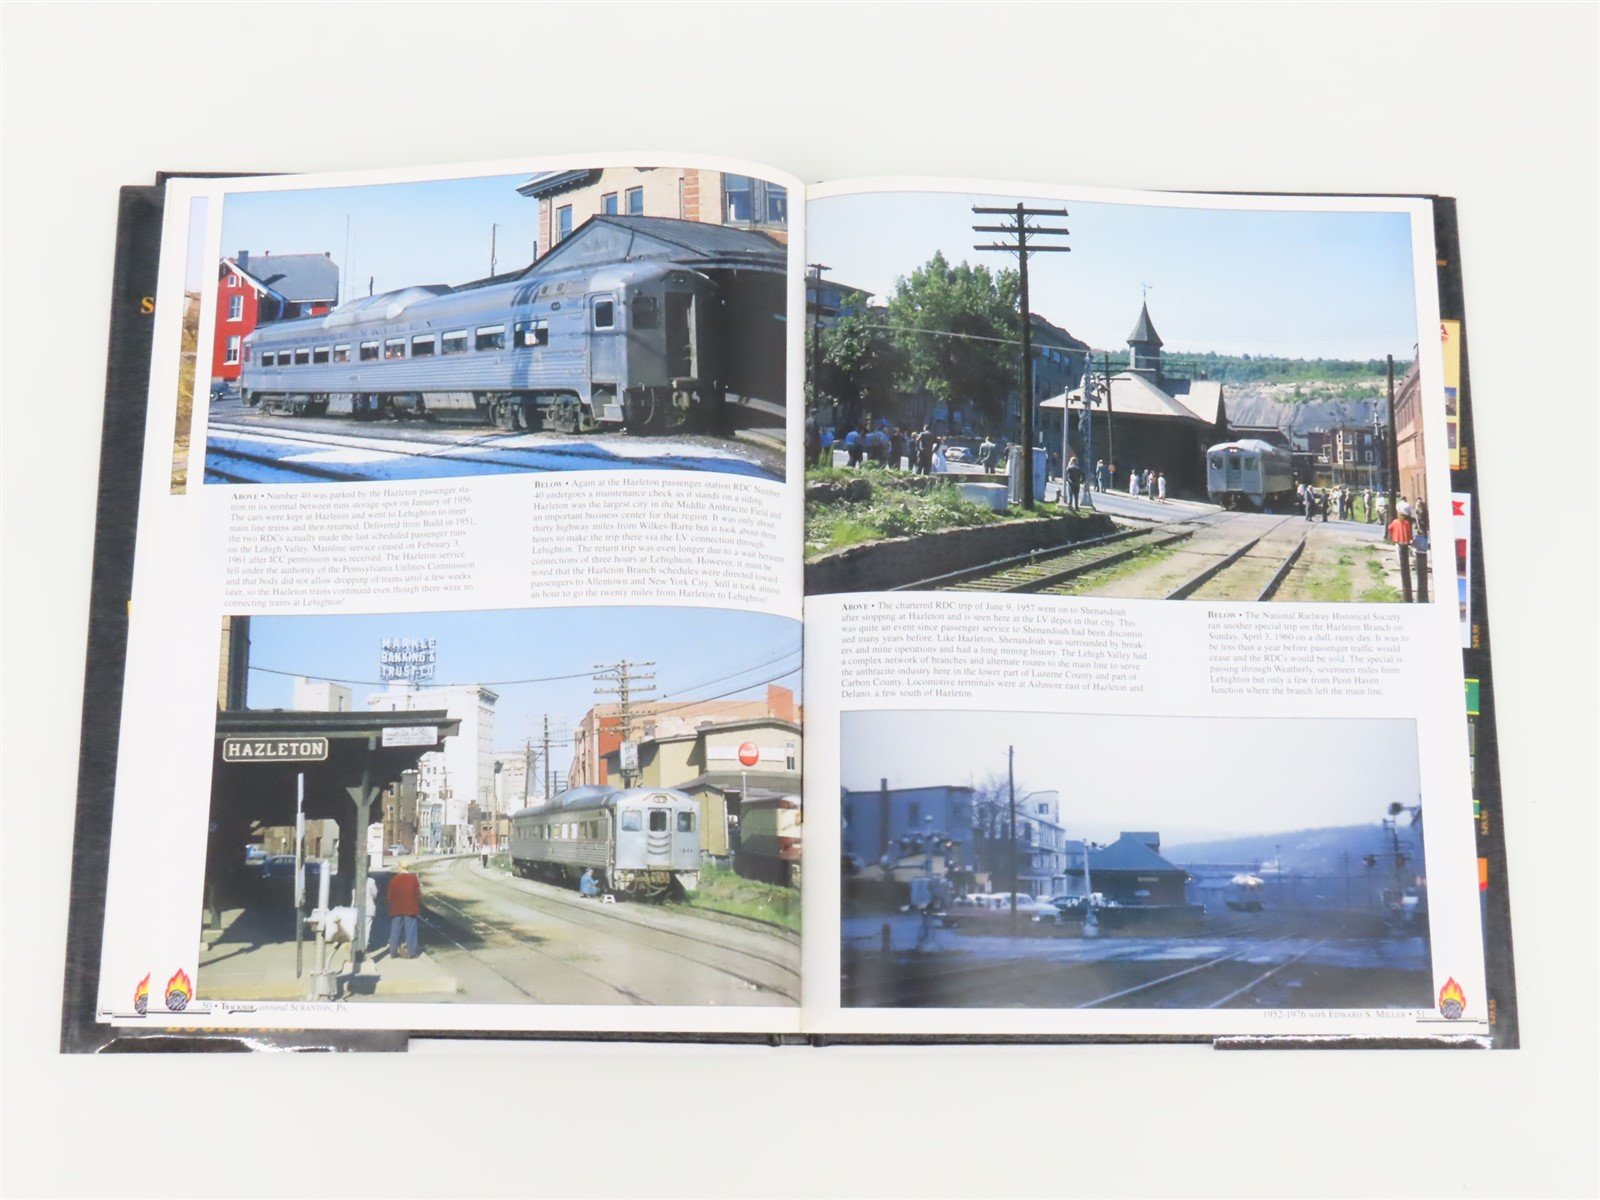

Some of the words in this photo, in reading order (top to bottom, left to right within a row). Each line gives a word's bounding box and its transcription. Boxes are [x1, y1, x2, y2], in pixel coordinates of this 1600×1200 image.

[266, 491, 299, 500] Number
[300, 491, 311, 500] 40
[329, 490, 356, 501] parked
[357, 490, 367, 500] by
[368, 489, 381, 498] the
[383, 487, 418, 497] Hazleton
[418, 488, 456, 498] passenger
[571, 478, 596, 490] Again
[597, 479, 605, 487] at
[607, 478, 620, 487] the
[622, 478, 660, 486] Hazleton
[661, 480, 702, 490] passenger
[704, 481, 730, 490] station
[732, 482, 751, 493] RDC
[754, 485, 780, 498] Number
[533, 501, 568, 510] Hazleton
[588, 500, 601, 509] the
[603, 500, 630, 511] largest
[632, 501, 648, 510] city
[661, 500, 674, 509] the
[676, 500, 706, 510] Middle
[708, 502, 748, 514] Anthracite
[750, 506, 768, 517] Field
[769, 509, 781, 520] and
[226, 566, 240, 574] fell
[241, 566, 264, 574] under
[266, 566, 278, 574] the
[280, 566, 314, 577] authority
[317, 566, 326, 574] of
[328, 565, 340, 574] the
[342, 564, 392, 576] Pennsylvania
[395, 562, 425, 572] Utilities
[427, 560, 475, 570] Commission
[257, 587, 270, 596] the
[272, 587, 307, 596] Hazleton
[332, 586, 371, 595] continued
[392, 584, 420, 595] though
[421, 583, 441, 592] there
[530, 580, 573, 590] passengers
[575, 578, 584, 586] to
[585, 576, 628, 586] Allentown
[630, 576, 646, 585] and
[648, 576, 666, 585] New
[669, 577, 688, 586] York
[713, 579, 730, 589] Still
[732, 581, 738, 589] it
[739, 581, 756, 592] took
[758, 584, 780, 595] almost
[877, 601, 893, 609] The
[894, 601, 933, 609] chartered
[935, 601, 956, 609] RDC
[958, 602, 973, 612] trip
[974, 602, 984, 610] of
[985, 602, 1005, 611] June
[1016, 603, 1035, 612] 1957
[1037, 605, 1056, 613] went
[1069, 606, 1078, 614] to
[1080, 606, 1126, 615] Shenandoah
[1244, 611, 1260, 619] The
[1262, 611, 1296, 620] National
[1296, 612, 1329, 622] Railway
[1332, 612, 1370, 621] Historical
[1372, 612, 1400, 623] Society
[1222, 621, 1252, 630] another
[1254, 622, 1282, 633] special
[1283, 623, 1298, 633] trip
[1311, 623, 1324, 631] the
[1326, 623, 1361, 631] Hazleton
[1363, 623, 1391, 631] Branch
[841, 635, 856, 643] ued
[857, 636, 879, 645] many
[882, 636, 904, 644] years
[936, 634, 955, 642] Like
[998, 635, 1046, 645] Shenandoah
[1064, 638, 1108, 647] surrounded
[1109, 639, 1118, 650] by
[1209, 665, 1239, 675] passing
[1241, 664, 1272, 675] through
[1316, 666, 1356, 674] seventeen
[1357, 665, 1379, 674] miles
[1380, 666, 1400, 674] from
[1208, 675, 1250, 686] Lehighton
[1250, 675, 1266, 683] but
[1266, 675, 1284, 686] only
[1293, 675, 1309, 684] few
[1310, 675, 1330, 684] from
[1330, 675, 1352, 684] Penn
[1352, 676, 1379, 685] Haven
[881, 688, 896, 697] few
[899, 688, 922, 697] south
[923, 688, 934, 697] of
[228, 742, 323, 757] HAZLETON
[258, 1002, 288, 1011] around
[1263, 1011, 1306, 1019] 1952-1976
[1308, 1011, 1326, 1019] with
